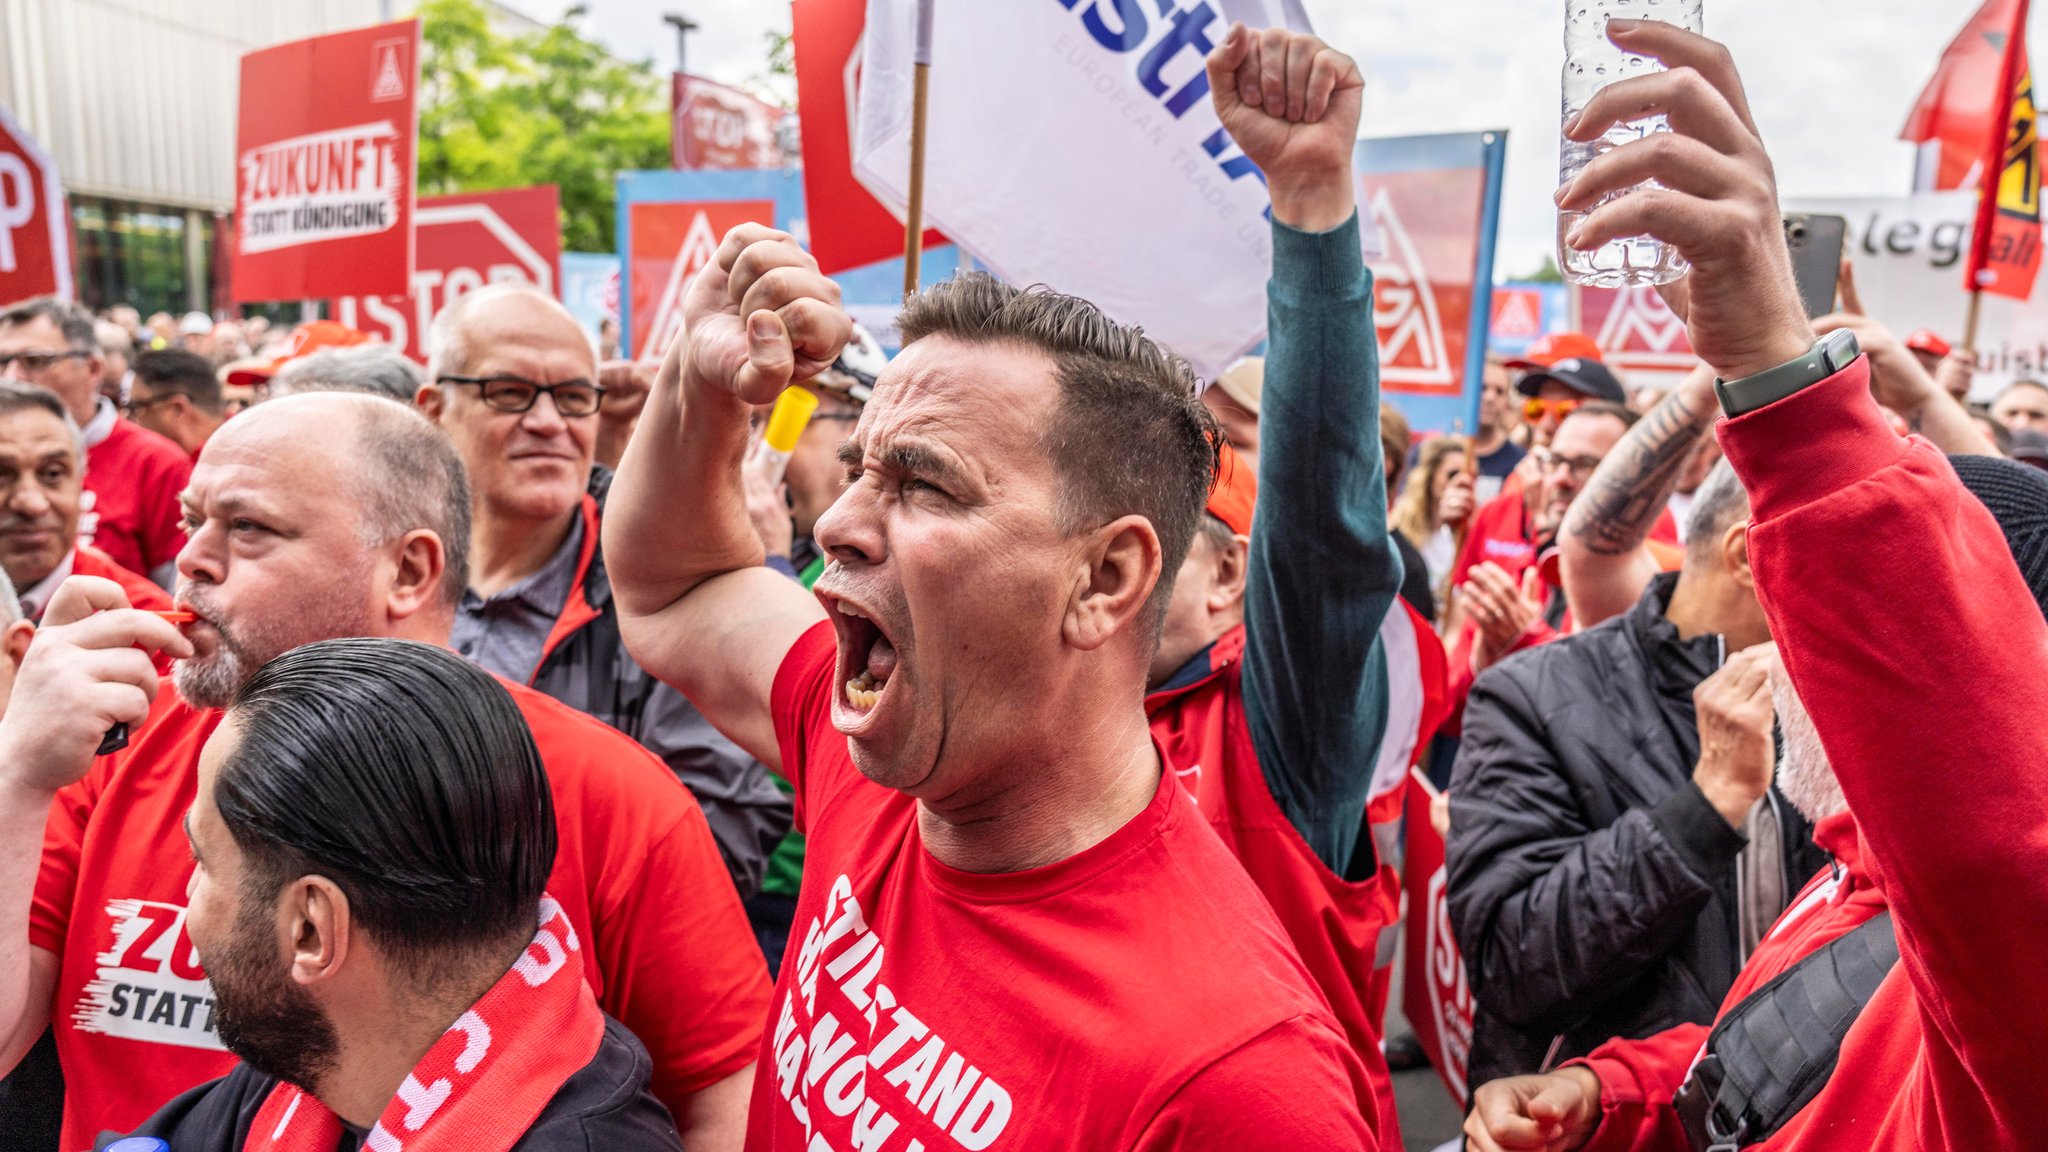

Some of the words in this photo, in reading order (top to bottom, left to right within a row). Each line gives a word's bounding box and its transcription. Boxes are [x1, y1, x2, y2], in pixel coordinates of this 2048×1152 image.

[1055, 34, 1169, 146] EUROPEAN
[1170, 146, 1240, 220] TRADE
[252, 136, 390, 200] ZUKUNFT
[252, 208, 291, 236] STATT
[293, 200, 387, 233] KÜNDIGUNG
[1850, 212, 1968, 267] leg
